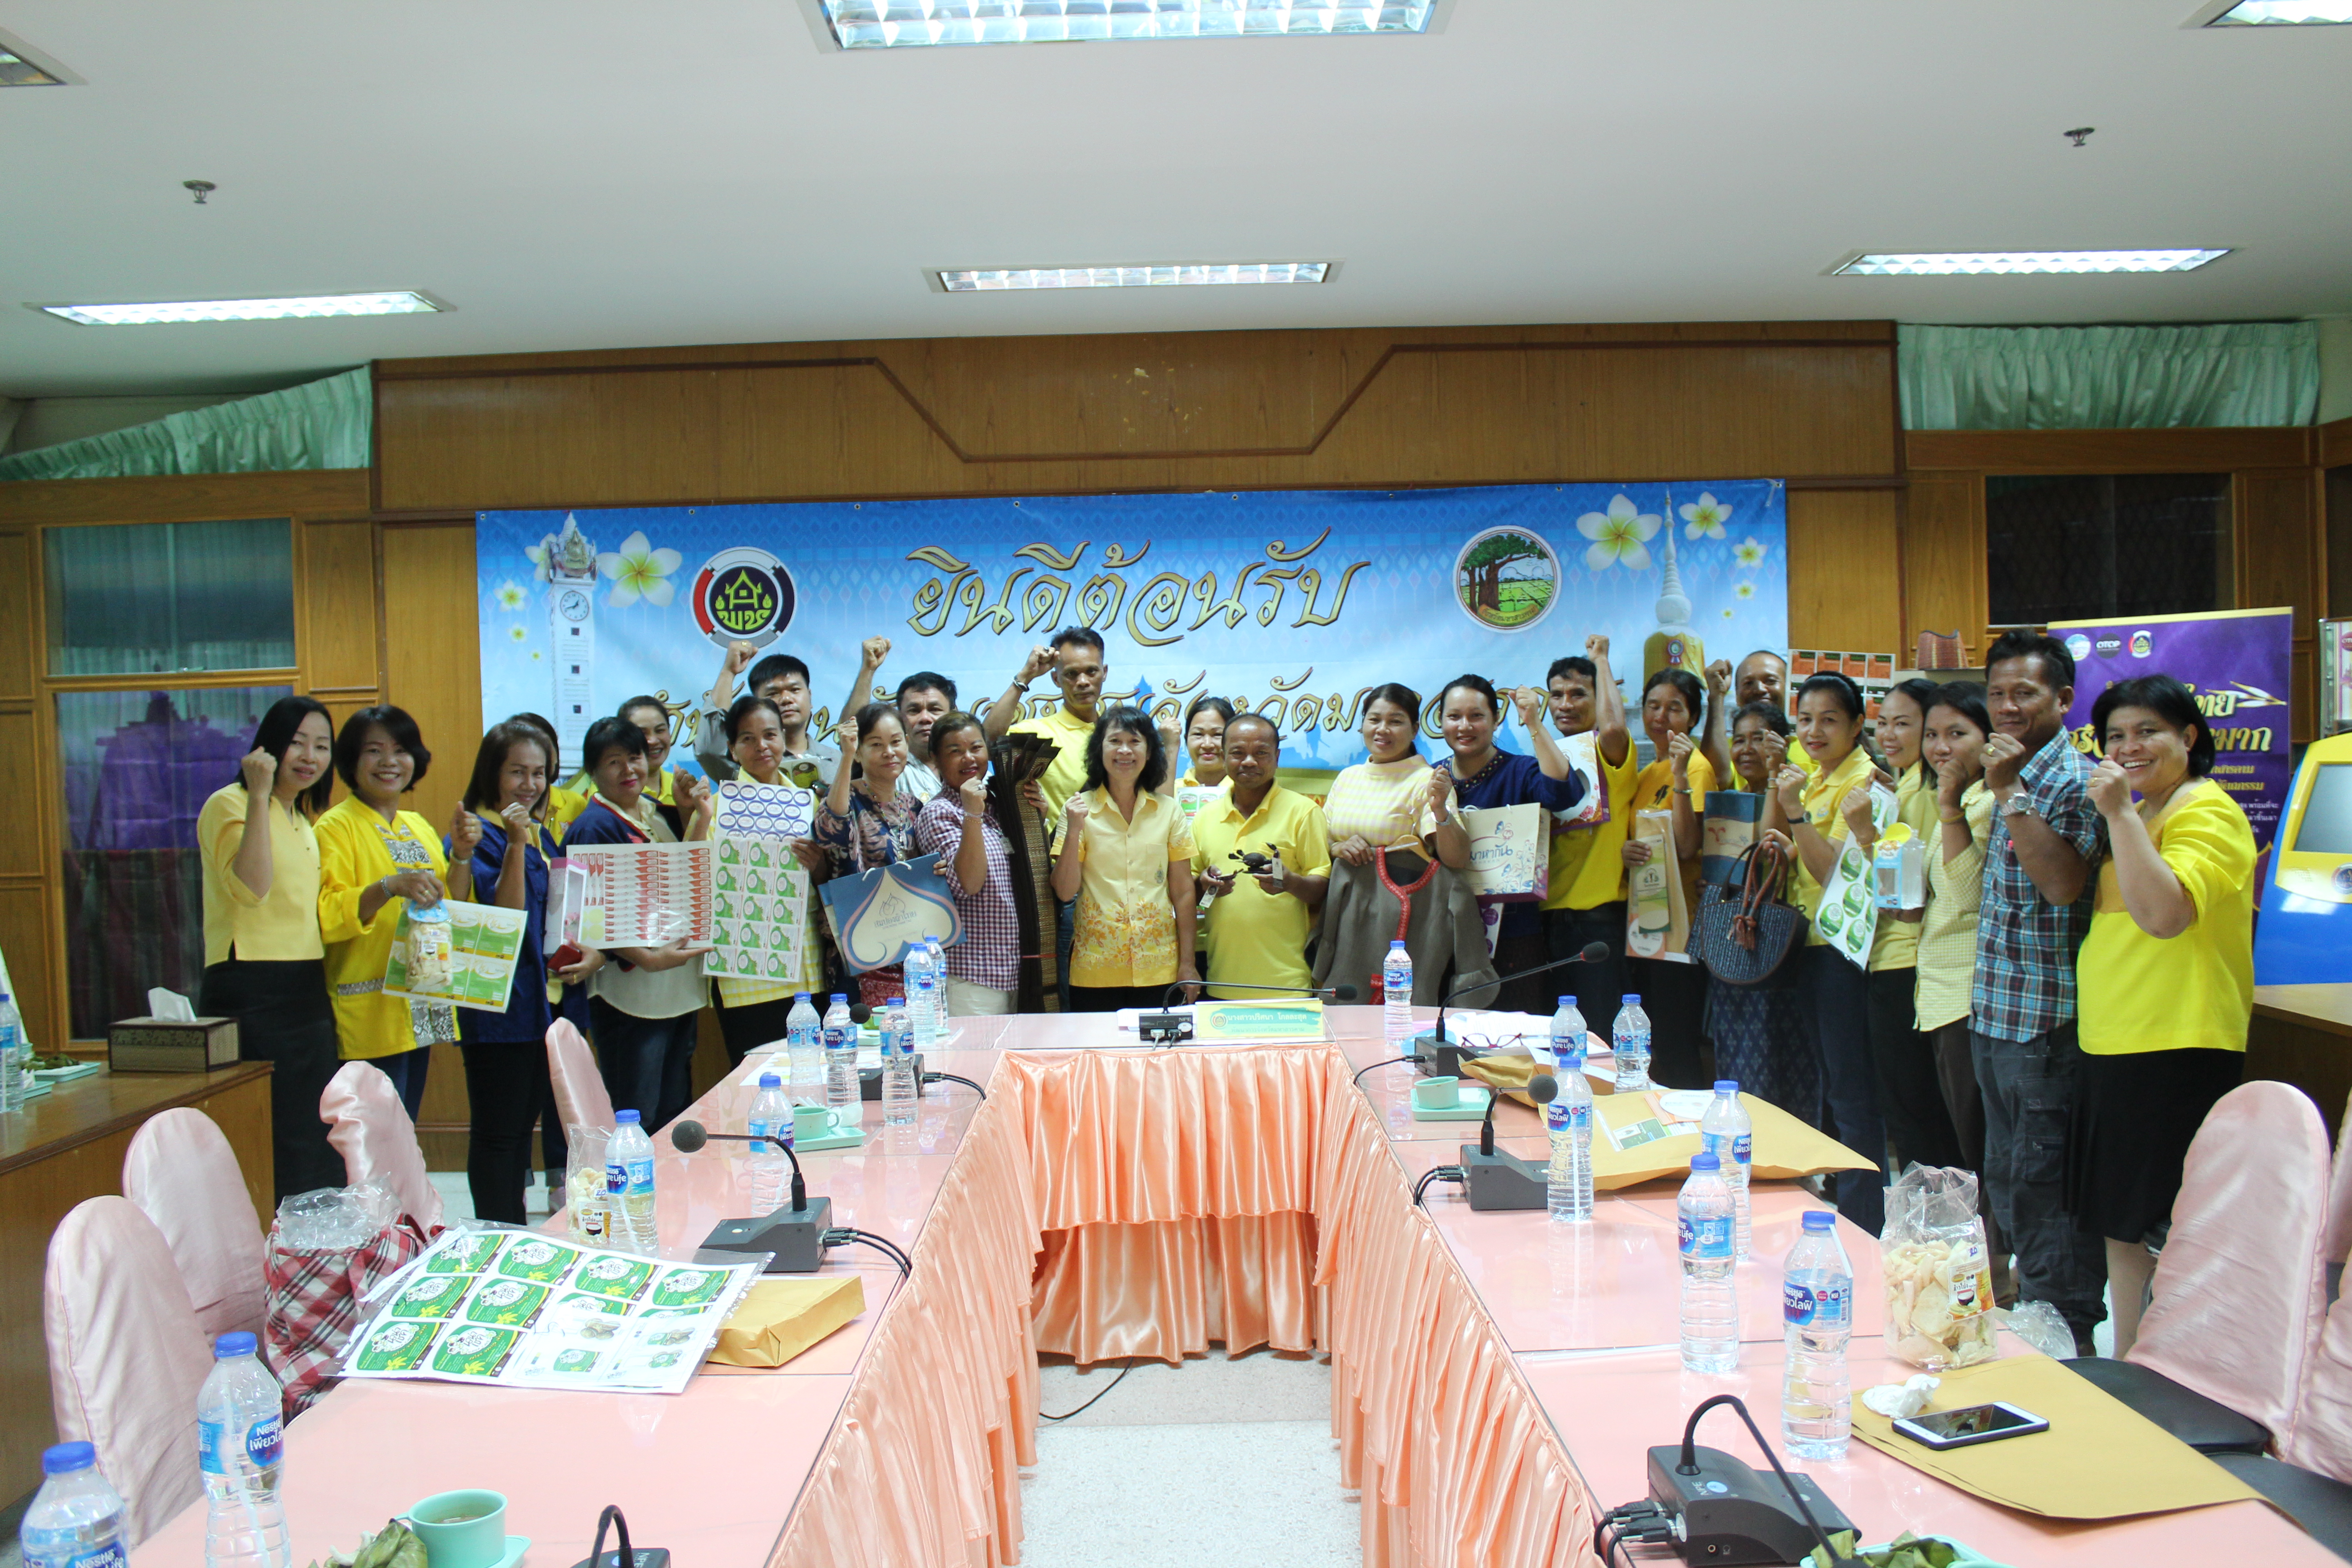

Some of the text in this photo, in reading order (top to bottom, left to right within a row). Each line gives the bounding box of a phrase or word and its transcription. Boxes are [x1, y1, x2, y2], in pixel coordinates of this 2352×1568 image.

[906, 526, 1371, 646] ยินดีต้อนรับ
[2096, 640, 2117, 649] OTOP
[1228, 1012, 1274, 1021] นางสาวปริศนา
[1564, 1043, 1574, 1051] Life
[613, 1174, 627, 1185] Life
[1681, 1229, 1694, 1242] Life
